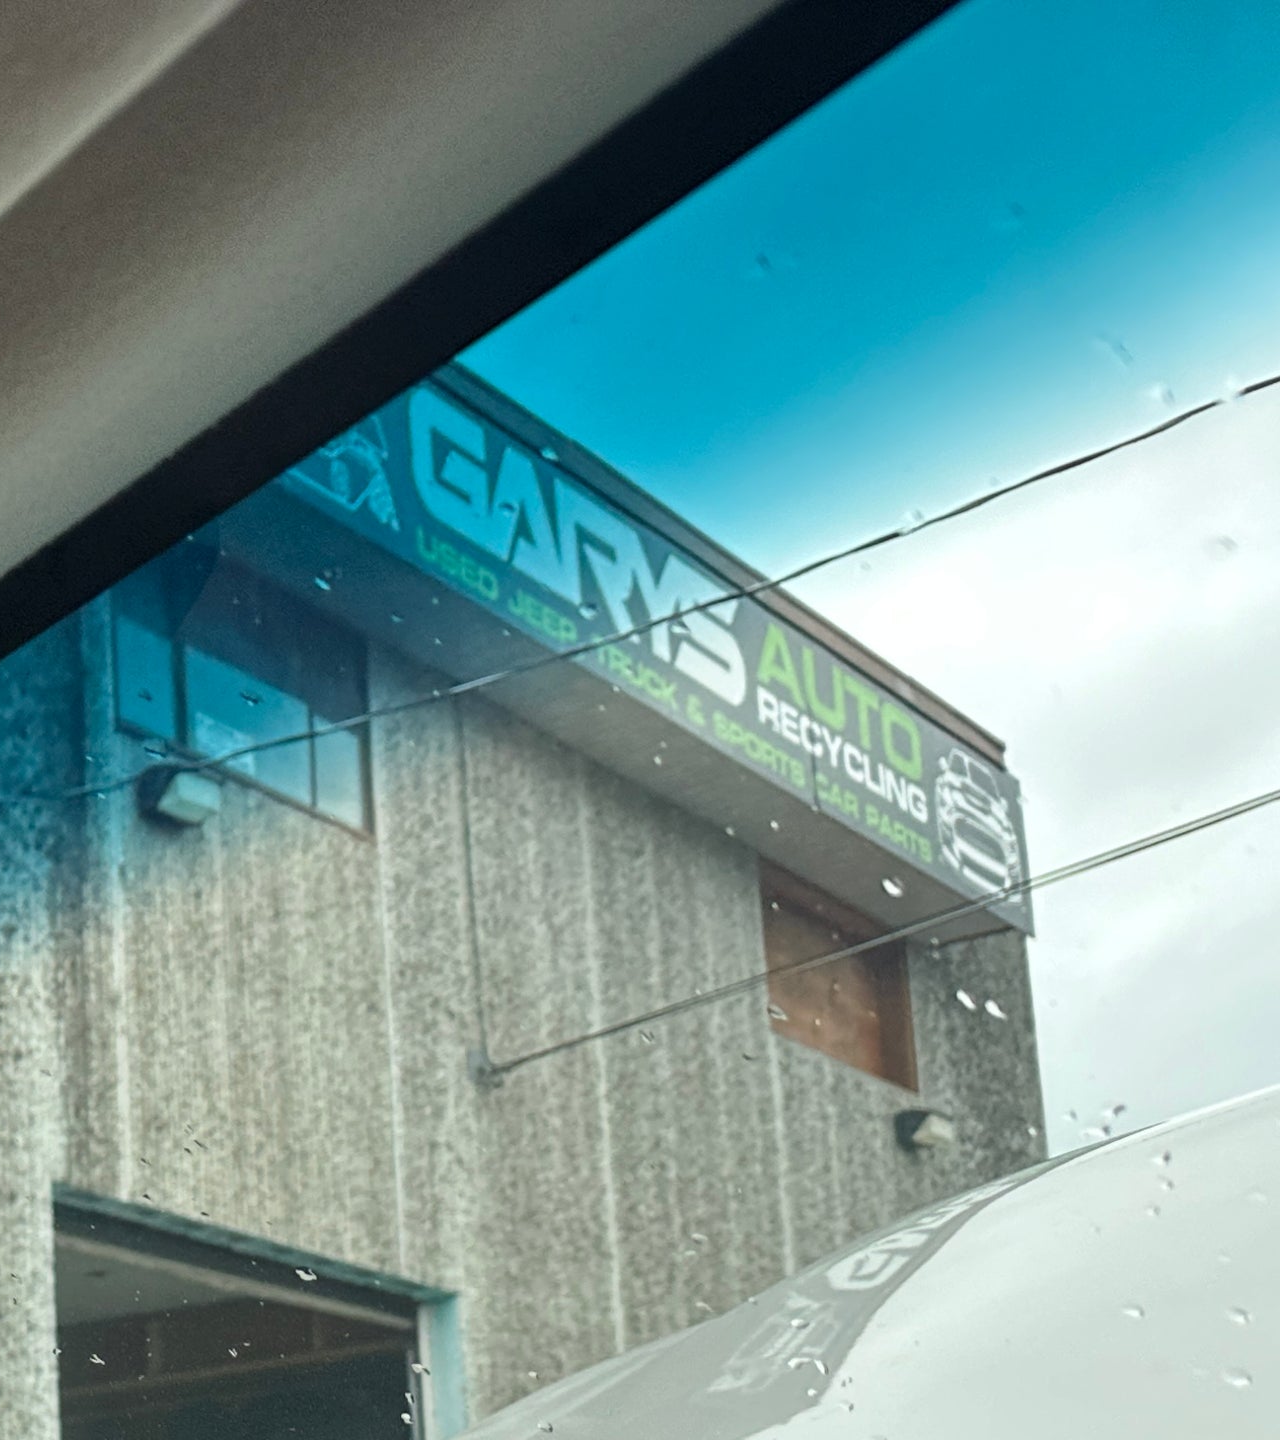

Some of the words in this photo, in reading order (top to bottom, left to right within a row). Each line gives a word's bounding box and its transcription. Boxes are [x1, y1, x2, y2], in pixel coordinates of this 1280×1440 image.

[416, 525, 500, 601] USED
[509, 588, 578, 644] JEEP
[592, 637, 680, 709] TRUCK
[712, 709, 807, 790] SPORTS
[814, 773, 860, 820] CAR
[865, 803, 934, 864] PARTS
[756, 685, 929, 824] RECYCLING
[757, 623, 924, 781] AUTO
